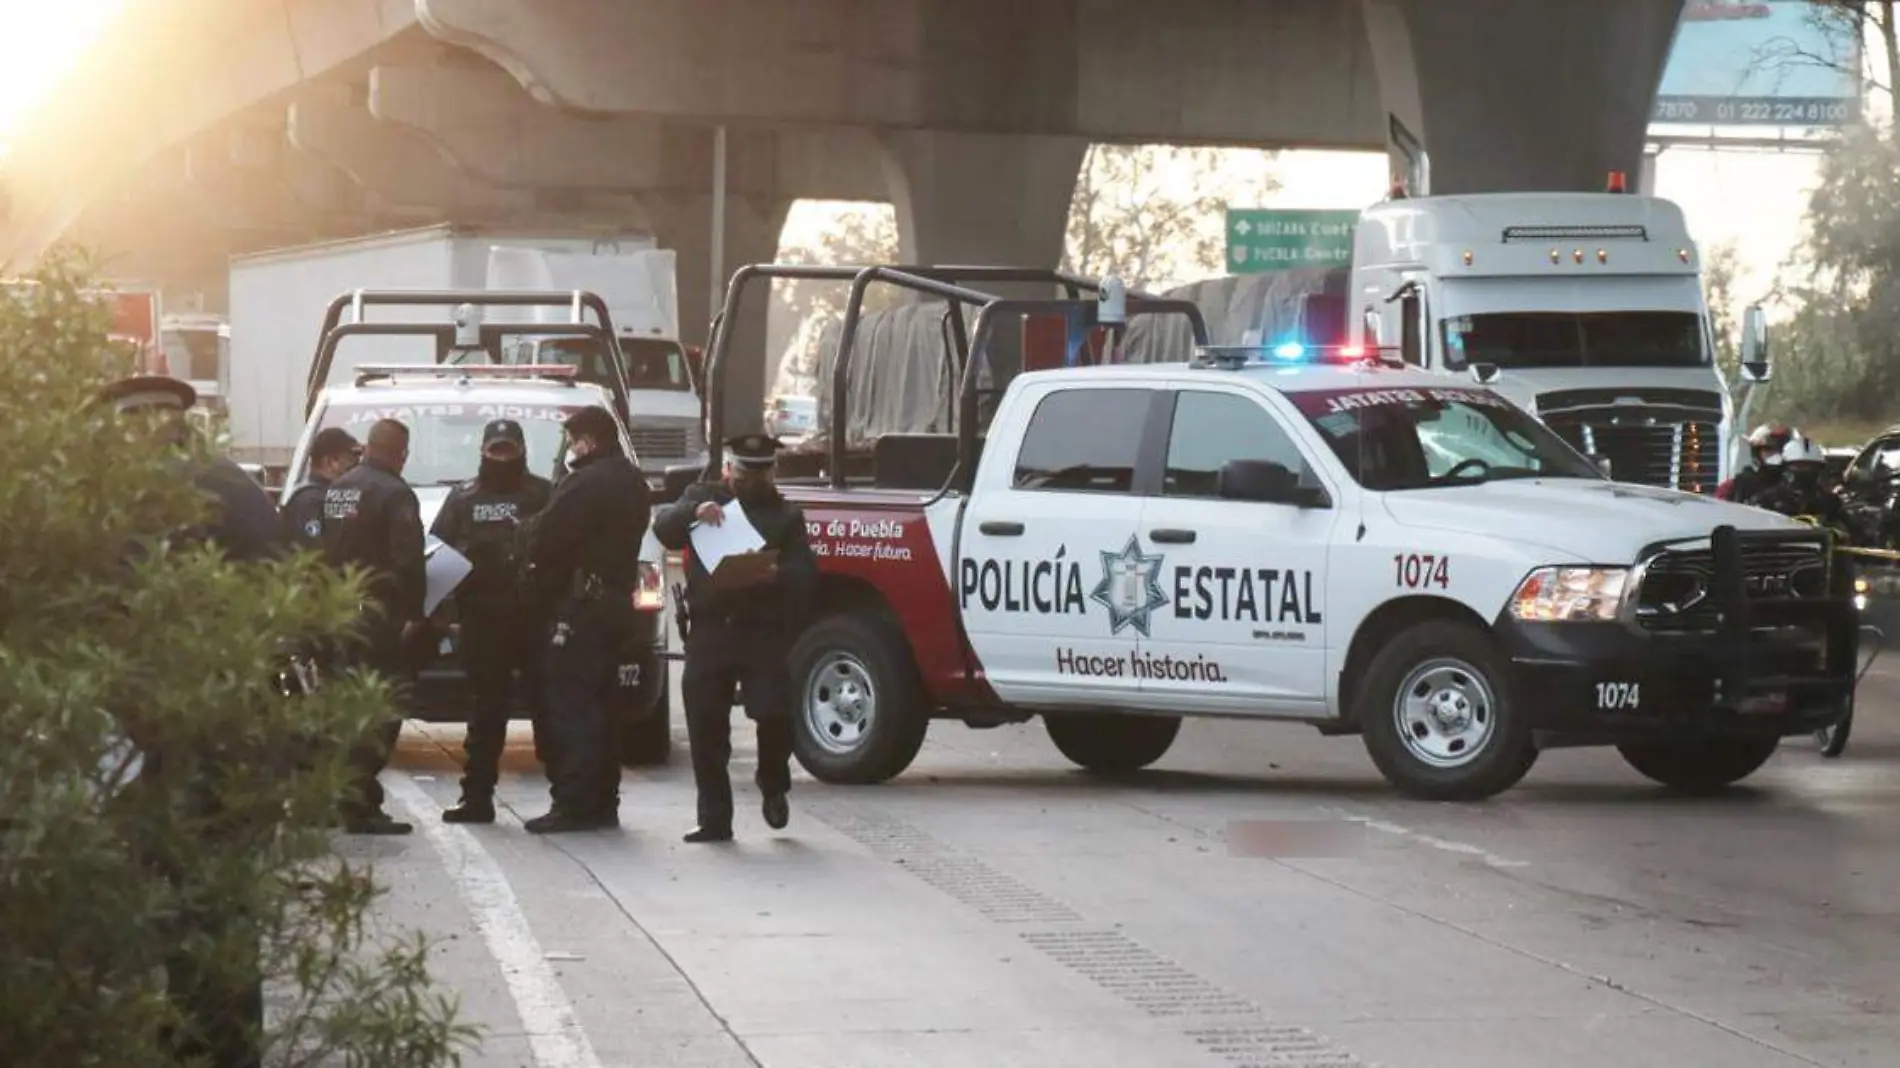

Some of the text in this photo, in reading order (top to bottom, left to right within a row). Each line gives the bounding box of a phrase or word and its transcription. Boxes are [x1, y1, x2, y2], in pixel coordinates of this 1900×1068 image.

[1717, 103, 1735, 119] 01
[1740, 103, 1771, 120] 222
[1774, 103, 1804, 120] 224
[827, 519, 846, 537] de
[849, 519, 903, 538] Puebla
[835, 540, 872, 557] Hacer
[961, 543, 1322, 624] POLICÍA ESTATAL
[1394, 554, 1450, 589] 1074
[1056, 647, 1228, 683] Hacer historia.
[1595, 682, 1640, 710] 1074
